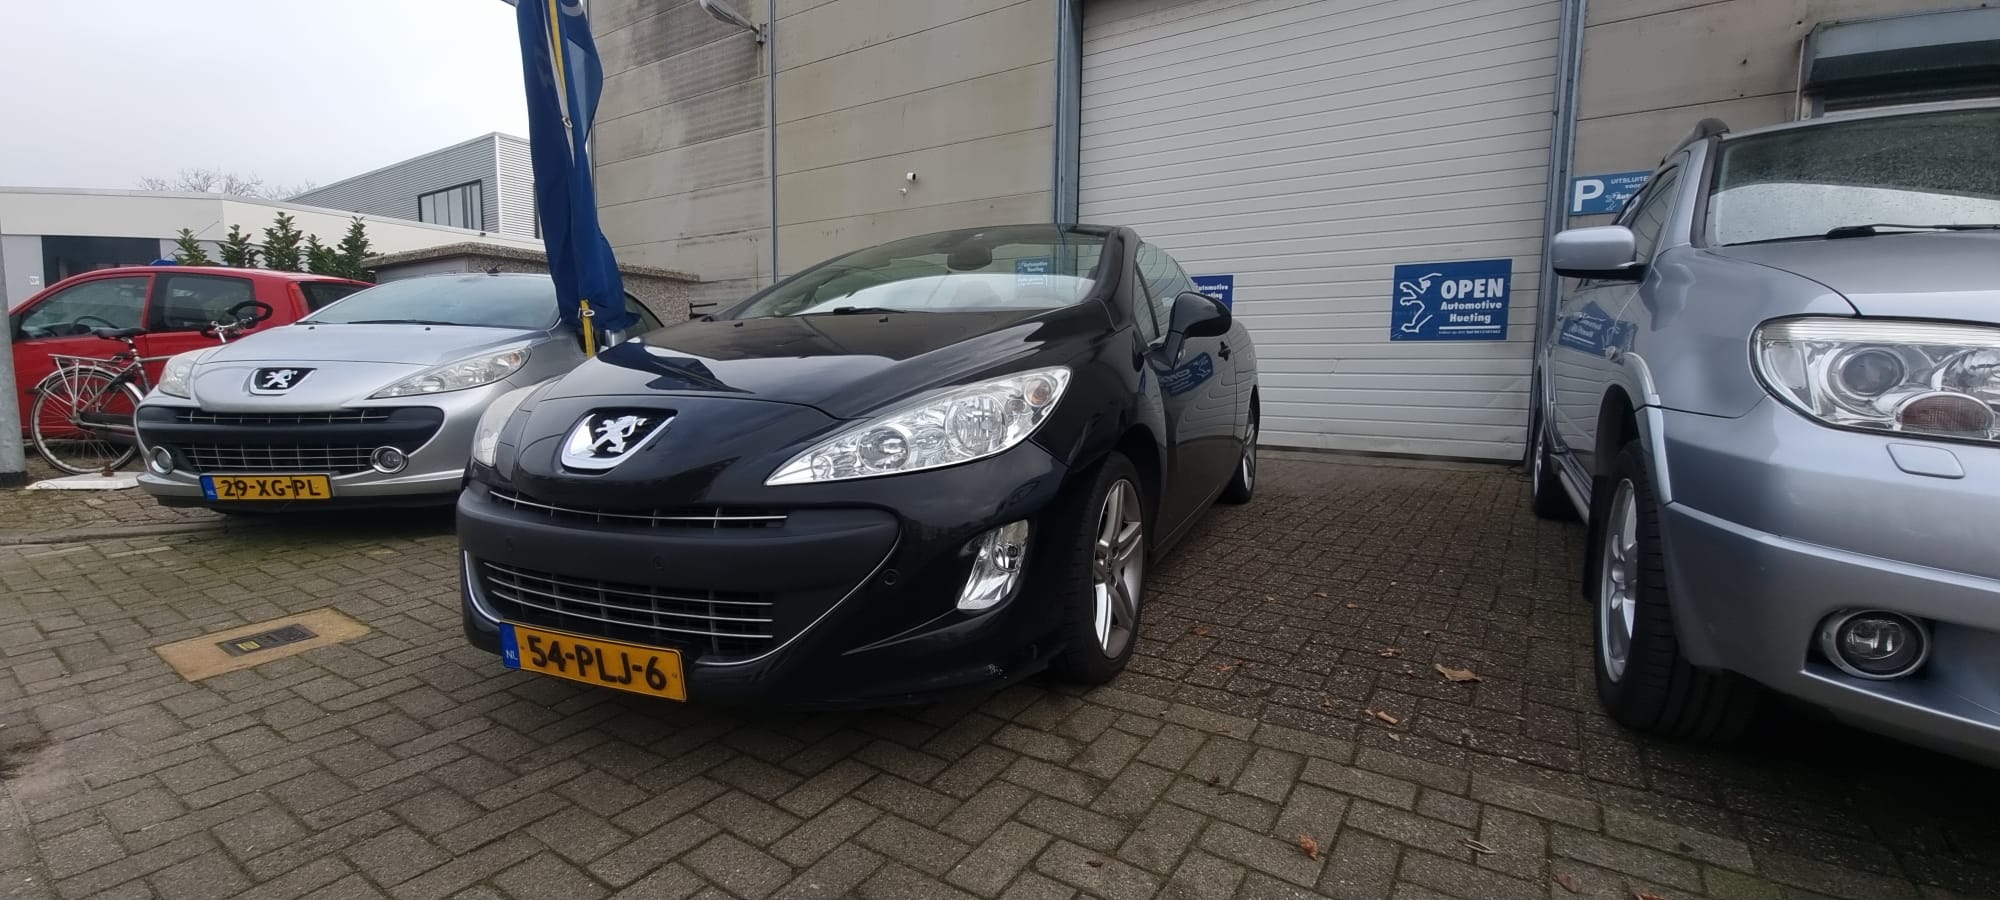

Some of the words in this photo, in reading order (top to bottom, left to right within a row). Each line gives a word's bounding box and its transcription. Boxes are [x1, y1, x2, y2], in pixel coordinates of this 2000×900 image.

[1611, 176, 1648, 184] UITSLUITE
[1573, 179, 1605, 212] P
[1441, 278, 1504, 299] OPEN
[1440, 299, 1503, 311] Automotive
[1449, 312, 1492, 324] Hueting
[220, 479, 322, 497] 29-XG-PL
[506, 649, 518, 661] NL
[527, 634, 668, 691] 54-PLJ-6
